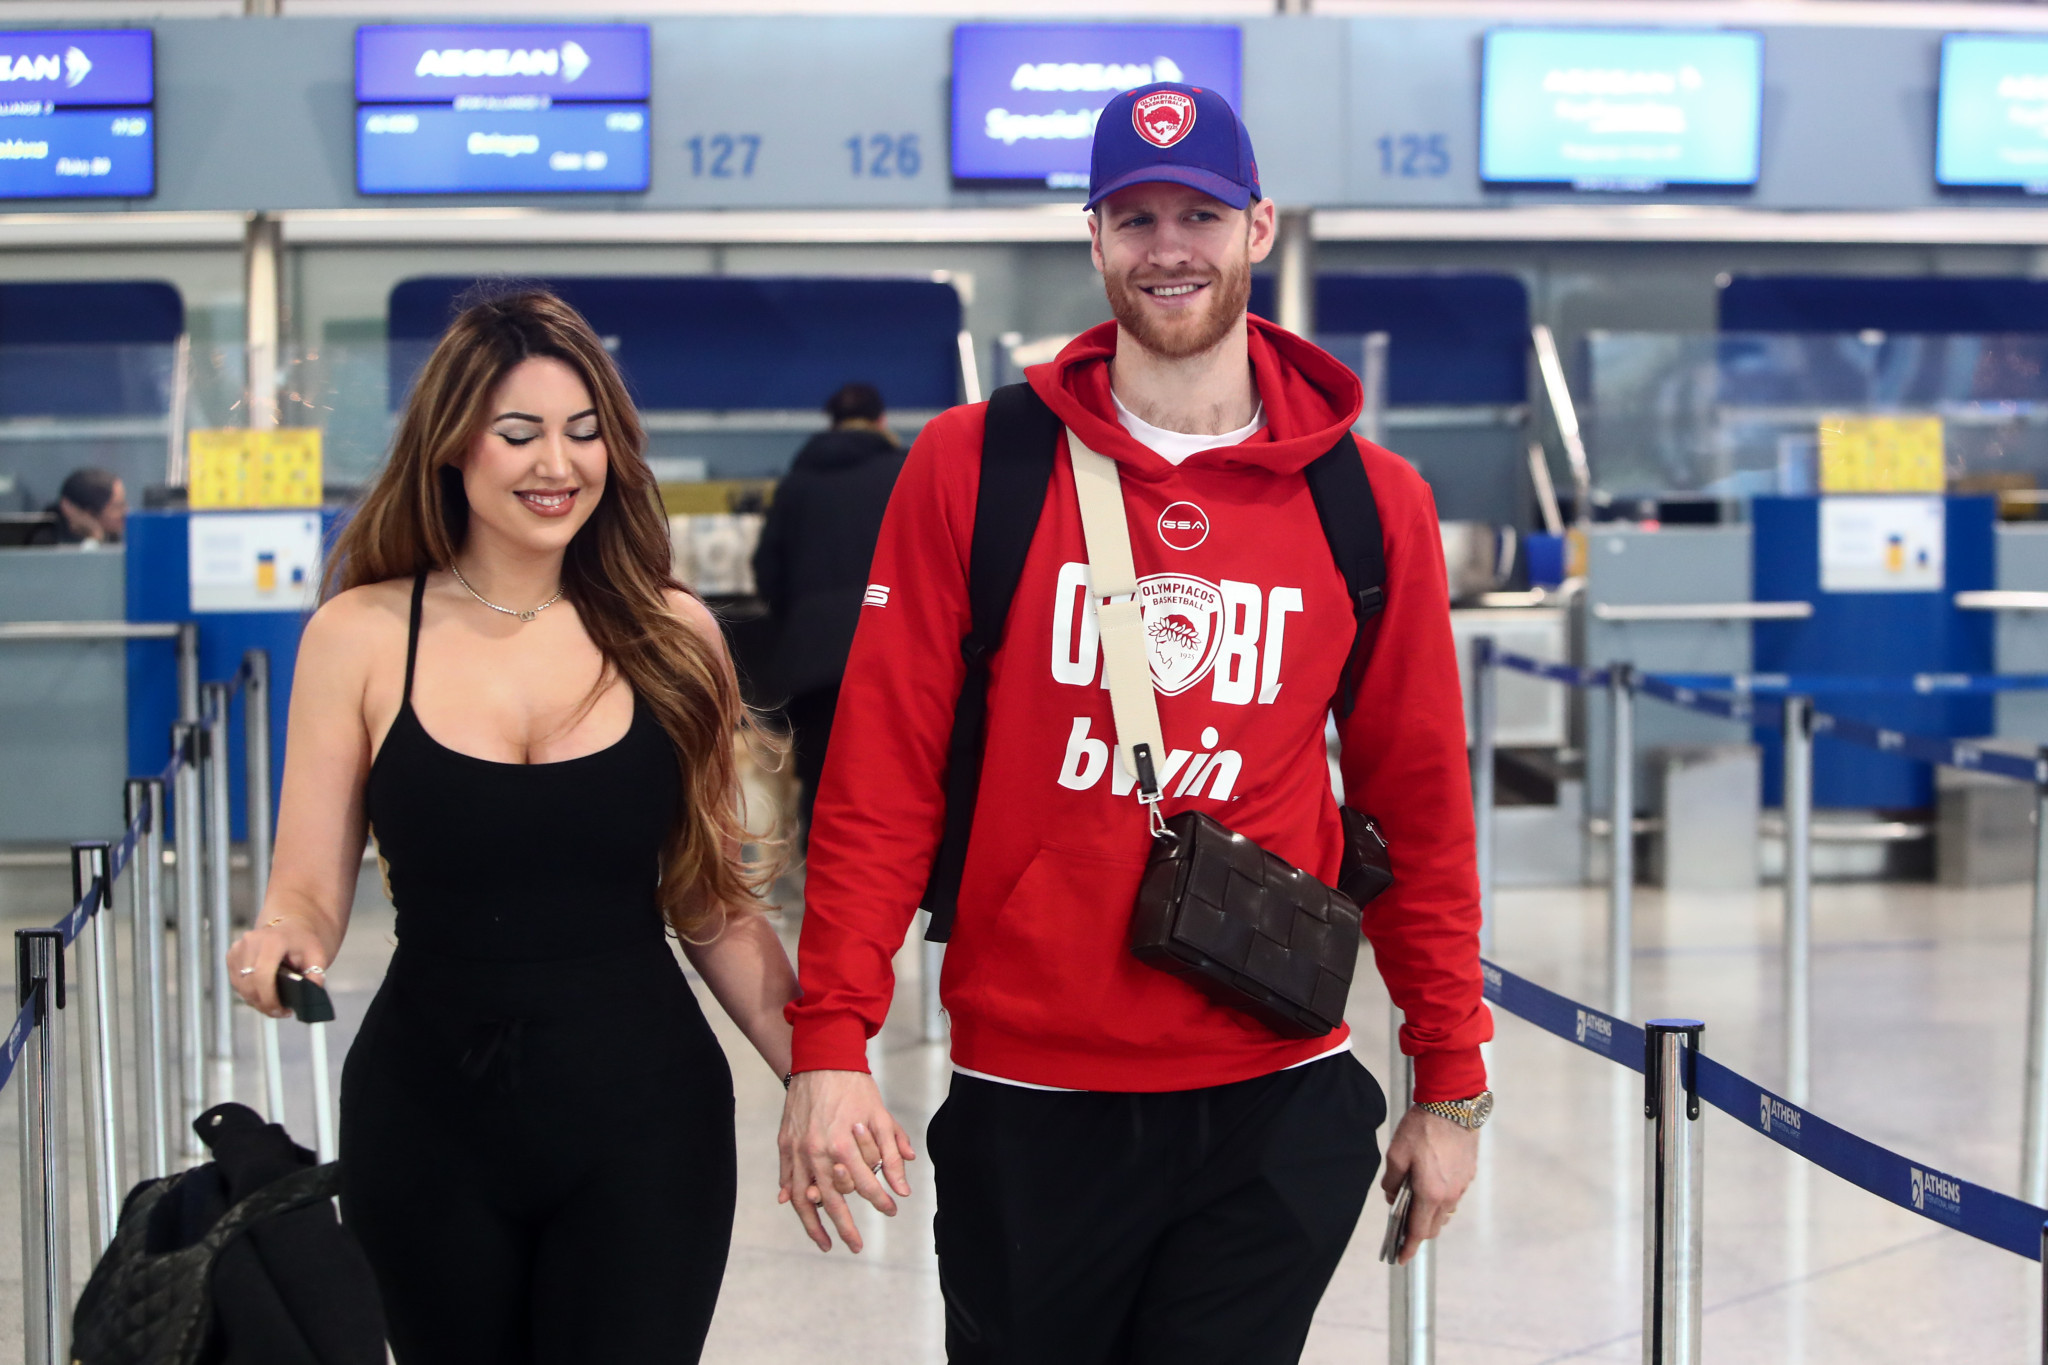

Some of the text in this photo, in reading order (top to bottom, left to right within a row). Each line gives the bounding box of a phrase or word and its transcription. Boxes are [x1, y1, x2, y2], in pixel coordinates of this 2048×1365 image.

[1140, 95, 1187, 107] OLYMPIACOS
[1144, 100, 1183, 109] BASKETBALL
[686, 133, 762, 179] 127
[846, 133, 922, 179] 126
[1376, 132, 1451, 178] 125
[1162, 520, 1205, 530] GSA
[1142, 583, 1216, 604] OLYMPIACOS
[1152, 596, 1205, 612] BASKETBALL
[1180, 652, 1195, 661] 1925
[1771, 1099, 1801, 1130] ATHENS
[1924, 1172, 1961, 1204] ATHENS
